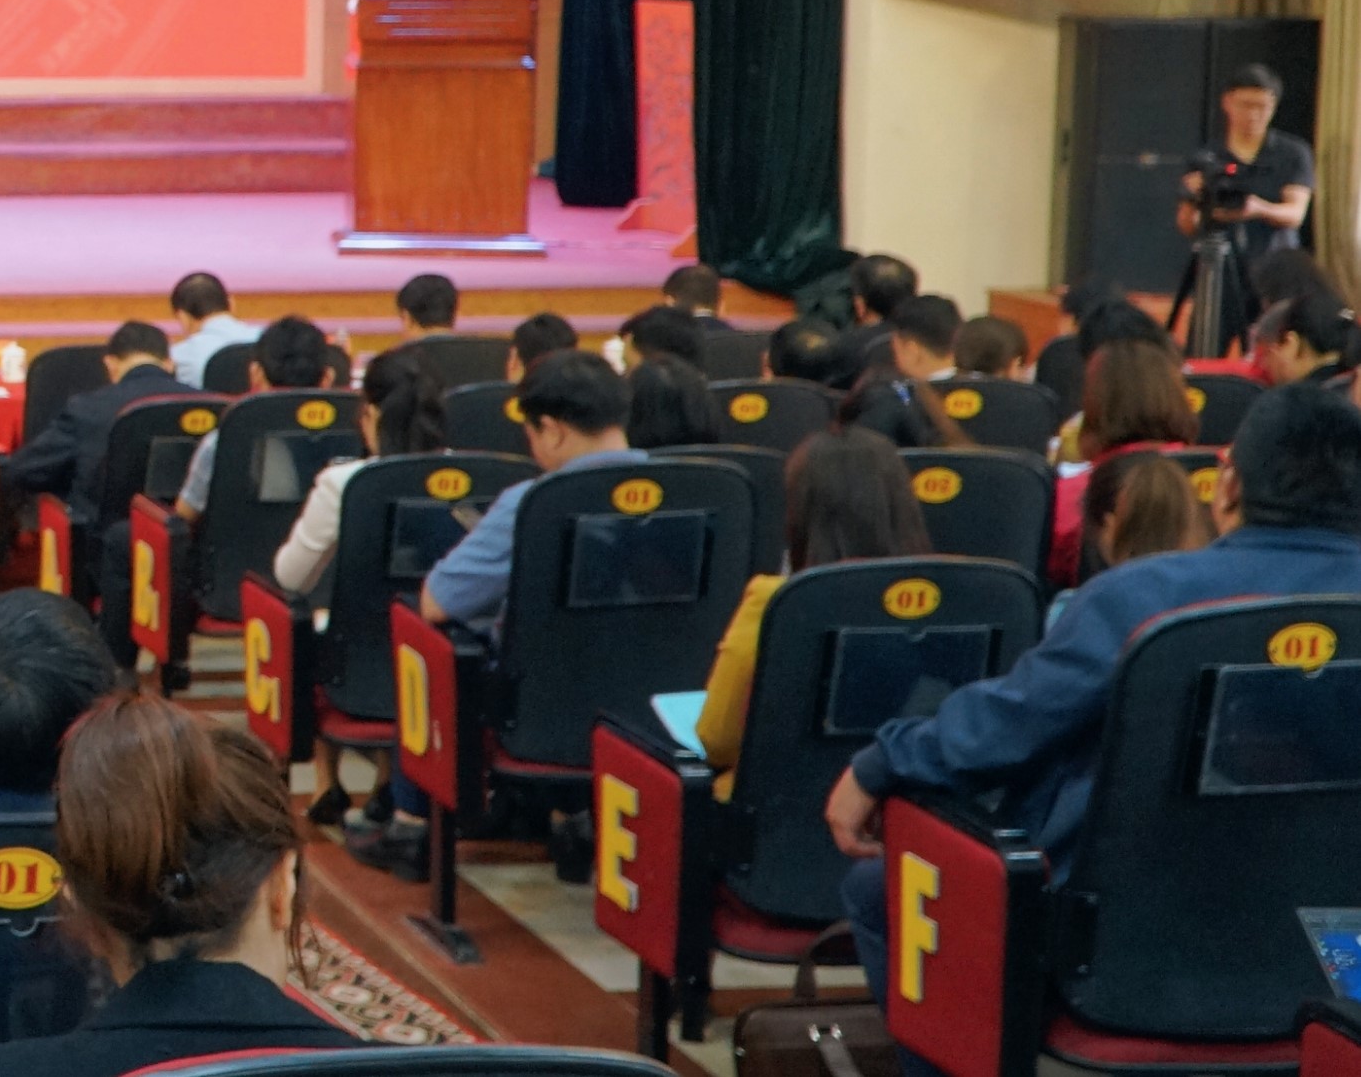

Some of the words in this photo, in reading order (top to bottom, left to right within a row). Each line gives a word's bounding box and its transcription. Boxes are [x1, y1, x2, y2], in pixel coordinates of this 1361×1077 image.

[1286, 638, 1319, 660] 01
[599, 773, 639, 912] E
[900, 851, 940, 1004] F
